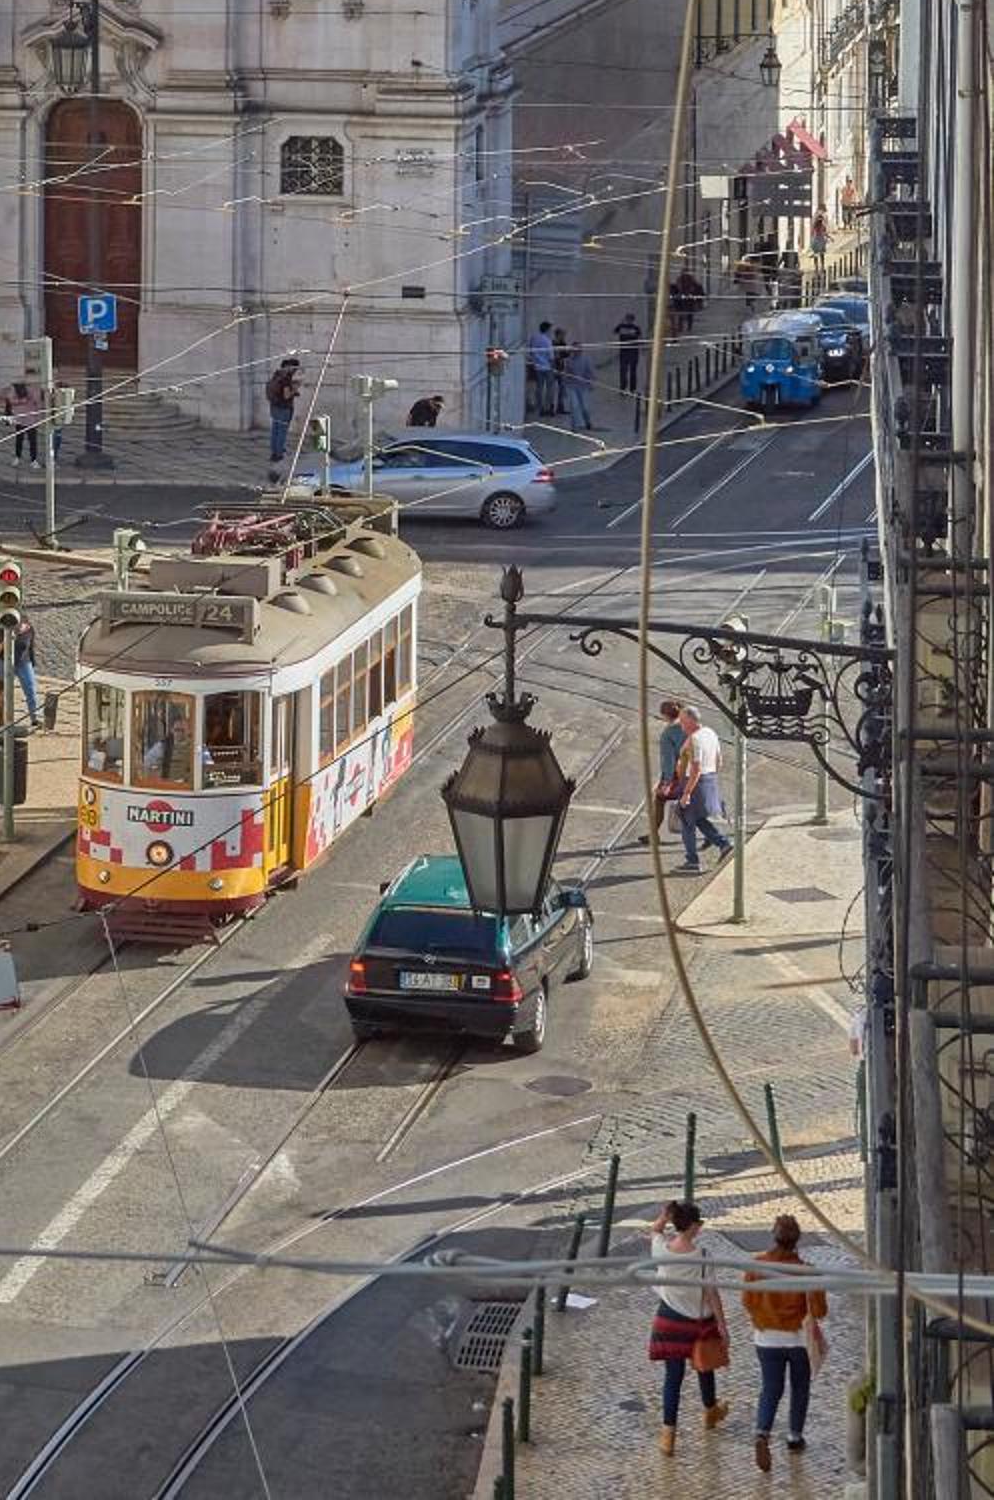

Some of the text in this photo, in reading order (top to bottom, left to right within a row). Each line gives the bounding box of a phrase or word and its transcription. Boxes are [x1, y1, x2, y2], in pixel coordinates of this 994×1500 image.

[87, 299, 107, 323] P
[206, 604, 233, 621] 24
[128, 806, 193, 826] MARTINI
